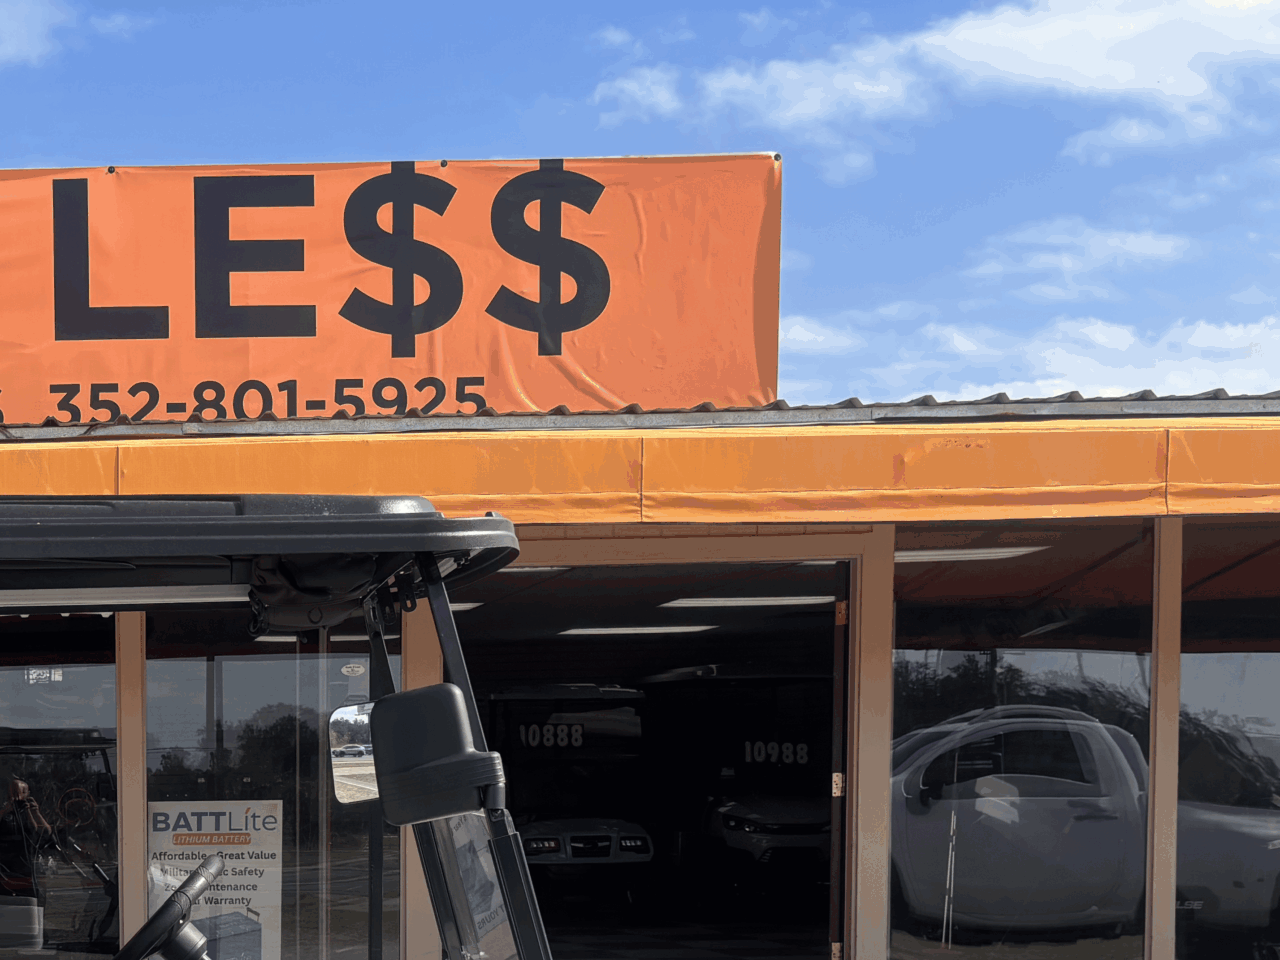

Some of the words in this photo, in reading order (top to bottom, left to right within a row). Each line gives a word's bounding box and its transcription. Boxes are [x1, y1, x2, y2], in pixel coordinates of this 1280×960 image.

[52, 158, 611, 358] LE$$
[48, 376, 488, 423] 352-801-5925
[745, 741, 808, 764] 10988
[173, 835, 210, 844] LITHIUM
[212, 835, 251, 844] BATTERY
[151, 851, 207, 861] Affordable
[247, 851, 277, 860] Value
[160, 867, 196, 877] Militar
[231, 867, 265, 878] Safety
[204, 896, 251, 906] Warranty
